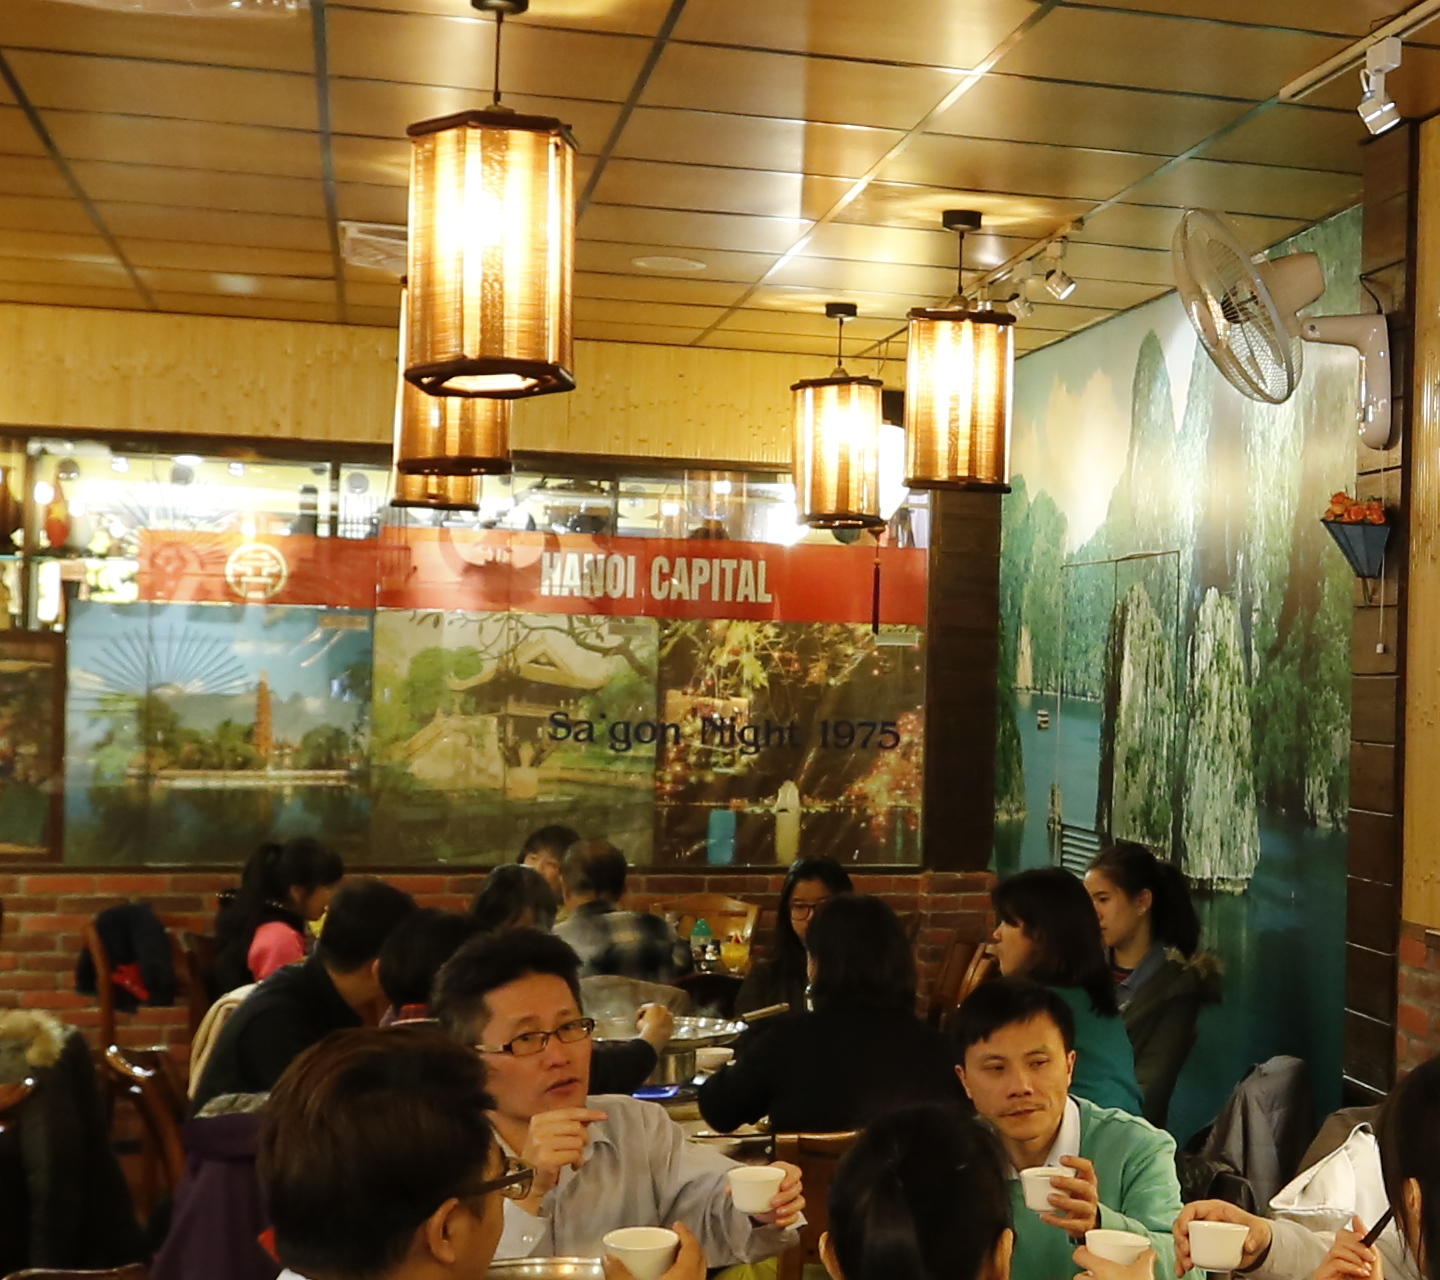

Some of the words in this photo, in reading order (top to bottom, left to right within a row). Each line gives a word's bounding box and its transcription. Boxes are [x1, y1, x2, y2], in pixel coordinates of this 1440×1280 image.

[539, 551, 636, 600] HANOI
[650, 554, 773, 604] CAPITAL
[548, 710, 681, 753] Sagon
[701, 714, 800, 755] Night
[821, 719, 901, 751] 1975
